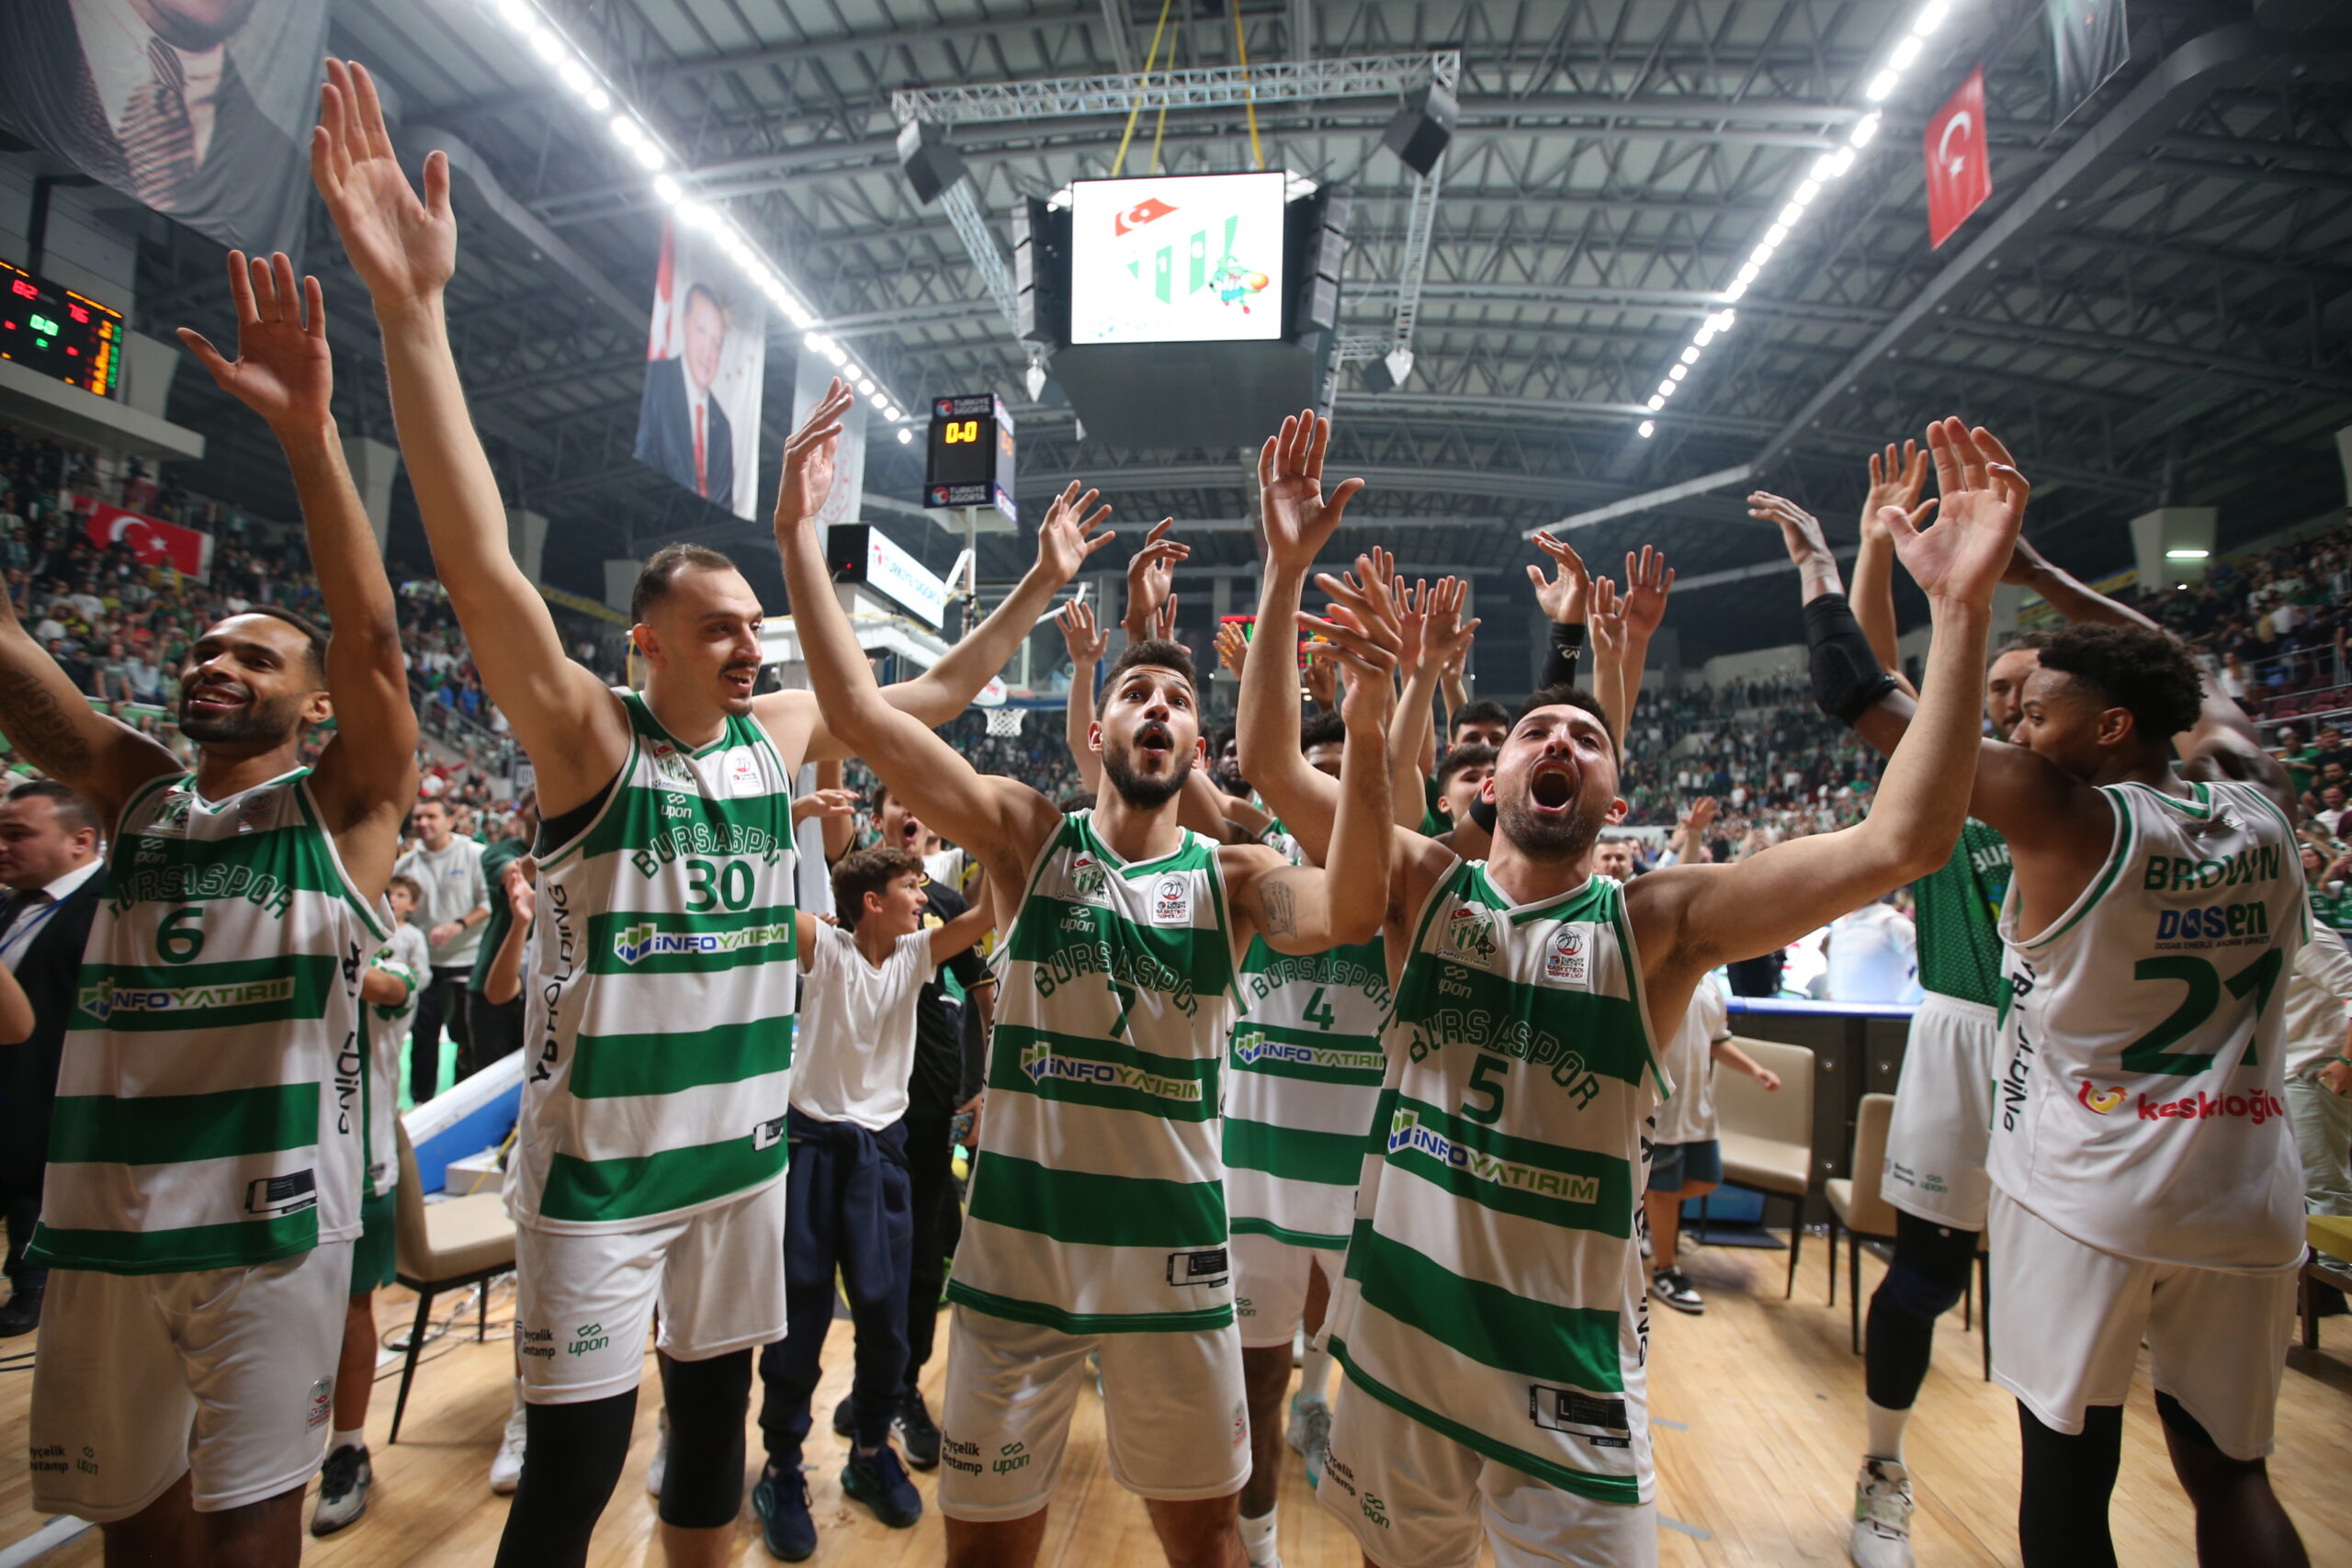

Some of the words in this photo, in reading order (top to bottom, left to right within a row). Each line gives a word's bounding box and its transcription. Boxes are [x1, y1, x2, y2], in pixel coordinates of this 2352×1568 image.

[661, 805, 692, 820] upon
[685, 860, 755, 912] 30
[2144, 843, 2281, 892] BROWN
[155, 906, 205, 964] 6
[1060, 919, 1095, 933] upon
[1107, 978, 1136, 1040] 7
[1303, 987, 1335, 1031] 4
[2120, 947, 2283, 1077] 21
[1262, 1043, 1385, 1068] iNFOYATIRI
[1460, 1054, 1510, 1125] 5
[568, 1336, 609, 1358] upon
[1560, 1398, 1570, 1416] L
[993, 1454, 1030, 1476] upon
